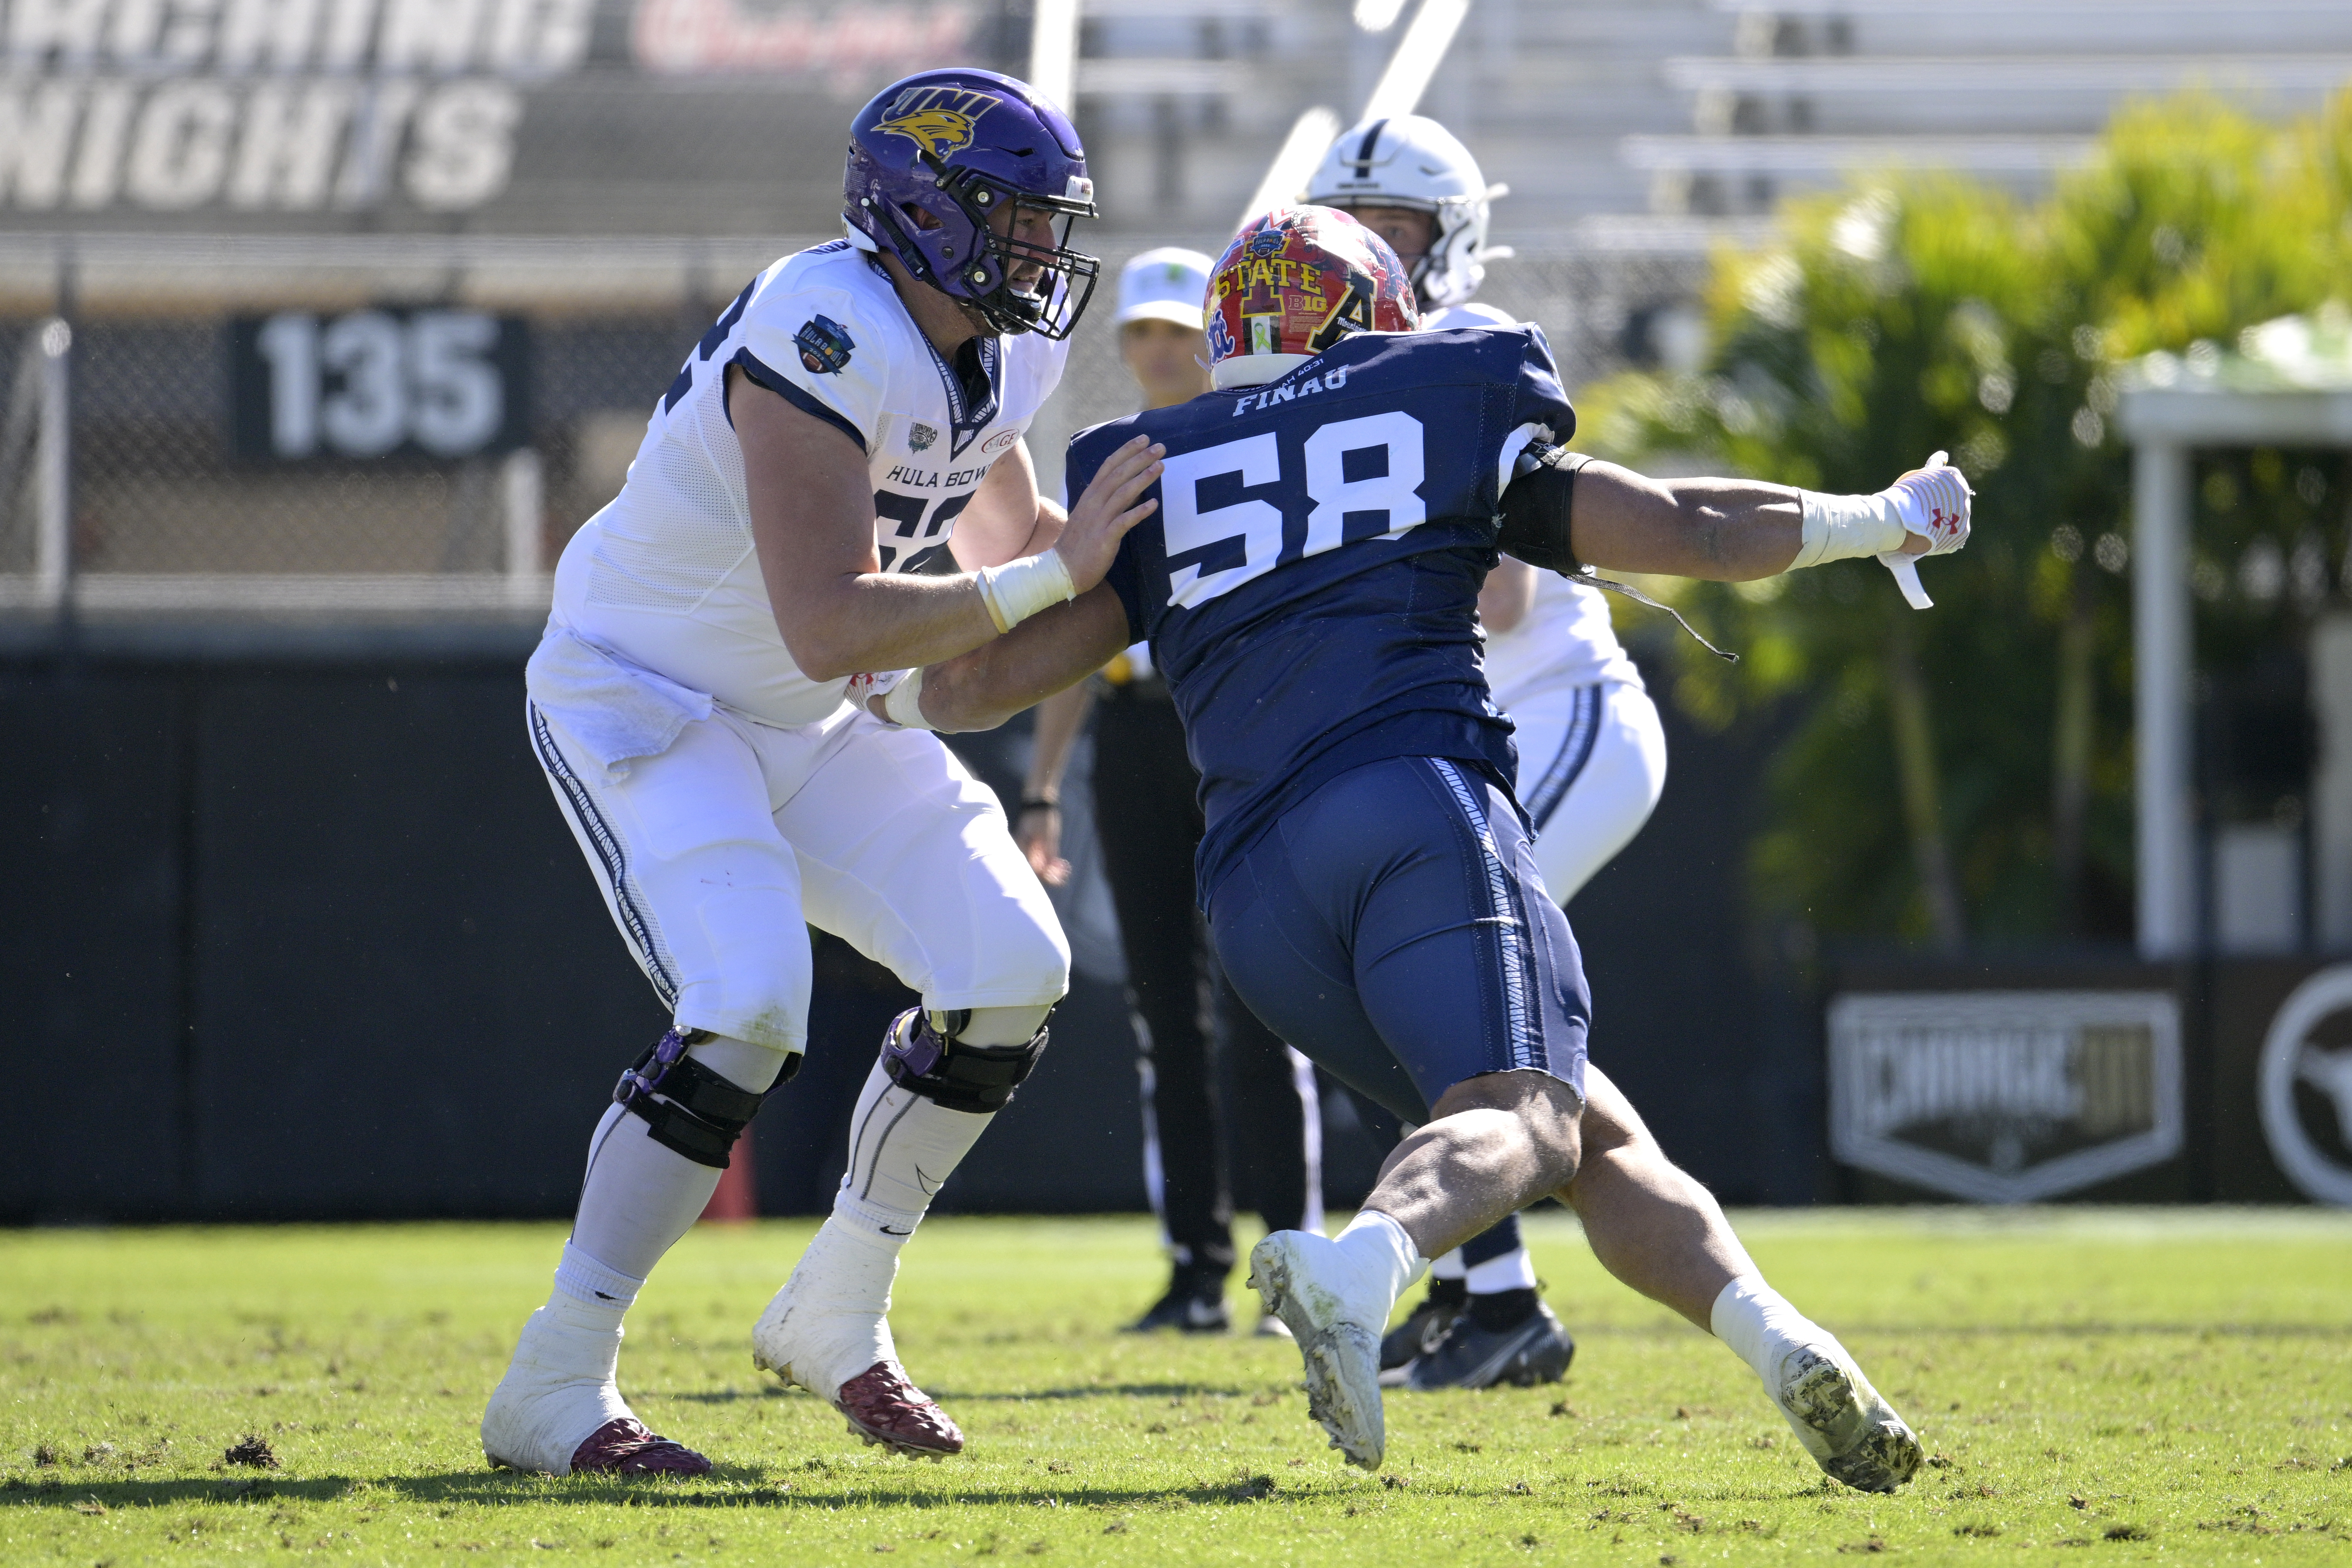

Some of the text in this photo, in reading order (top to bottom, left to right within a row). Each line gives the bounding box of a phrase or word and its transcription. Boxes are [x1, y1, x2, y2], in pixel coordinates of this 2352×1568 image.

[882, 87, 1003, 128] UNI
[1215, 258, 1323, 300] STATE
[809, 348, 824, 360] 2023
[1298, 358, 1324, 376] 40:31
[256, 311, 506, 459] 135
[1232, 364, 1349, 417] FINAU
[985, 431, 1017, 450] SAGE
[886, 465, 938, 488] HULA
[1161, 411, 1426, 610] 58
